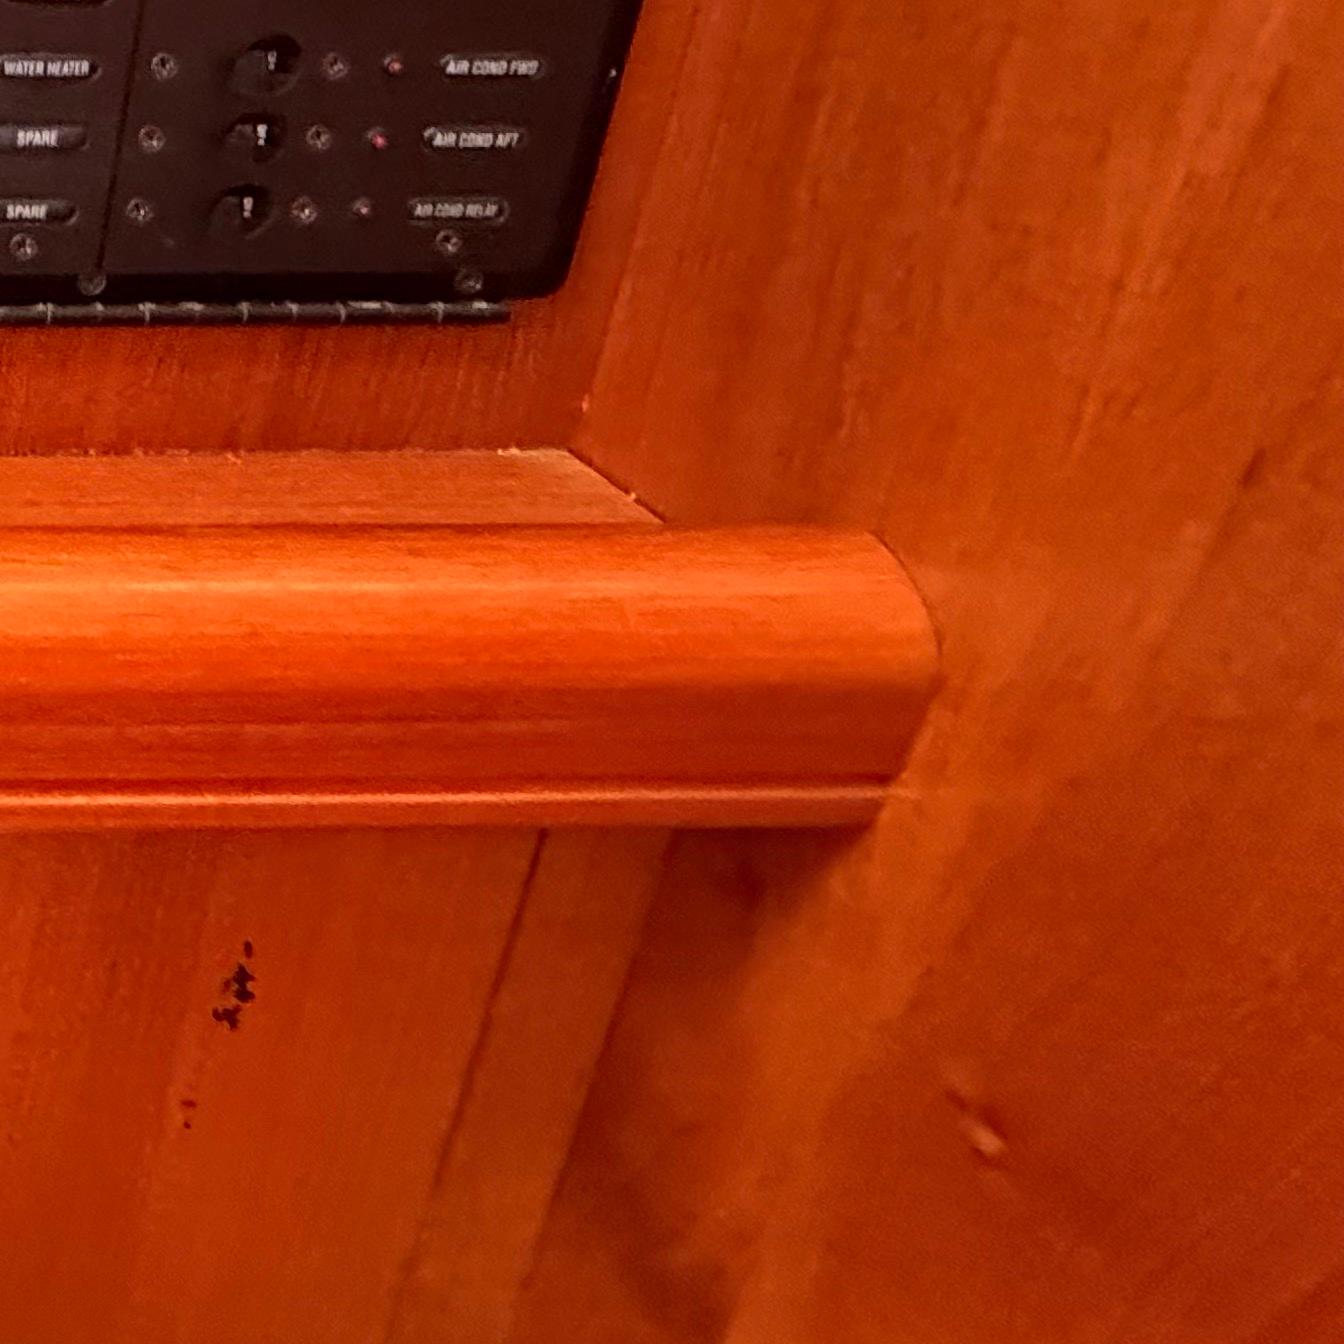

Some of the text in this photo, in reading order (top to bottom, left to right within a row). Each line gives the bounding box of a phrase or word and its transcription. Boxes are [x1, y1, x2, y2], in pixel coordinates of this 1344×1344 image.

[3, 60, 90, 77] WATER HEATER
[446, 60, 470, 75] AIR
[16, 129, 59, 148] SPARE
[432, 132, 457, 148] AIR
[495, 132, 519, 148] AFT
[7, 204, 49, 221] SPARE
